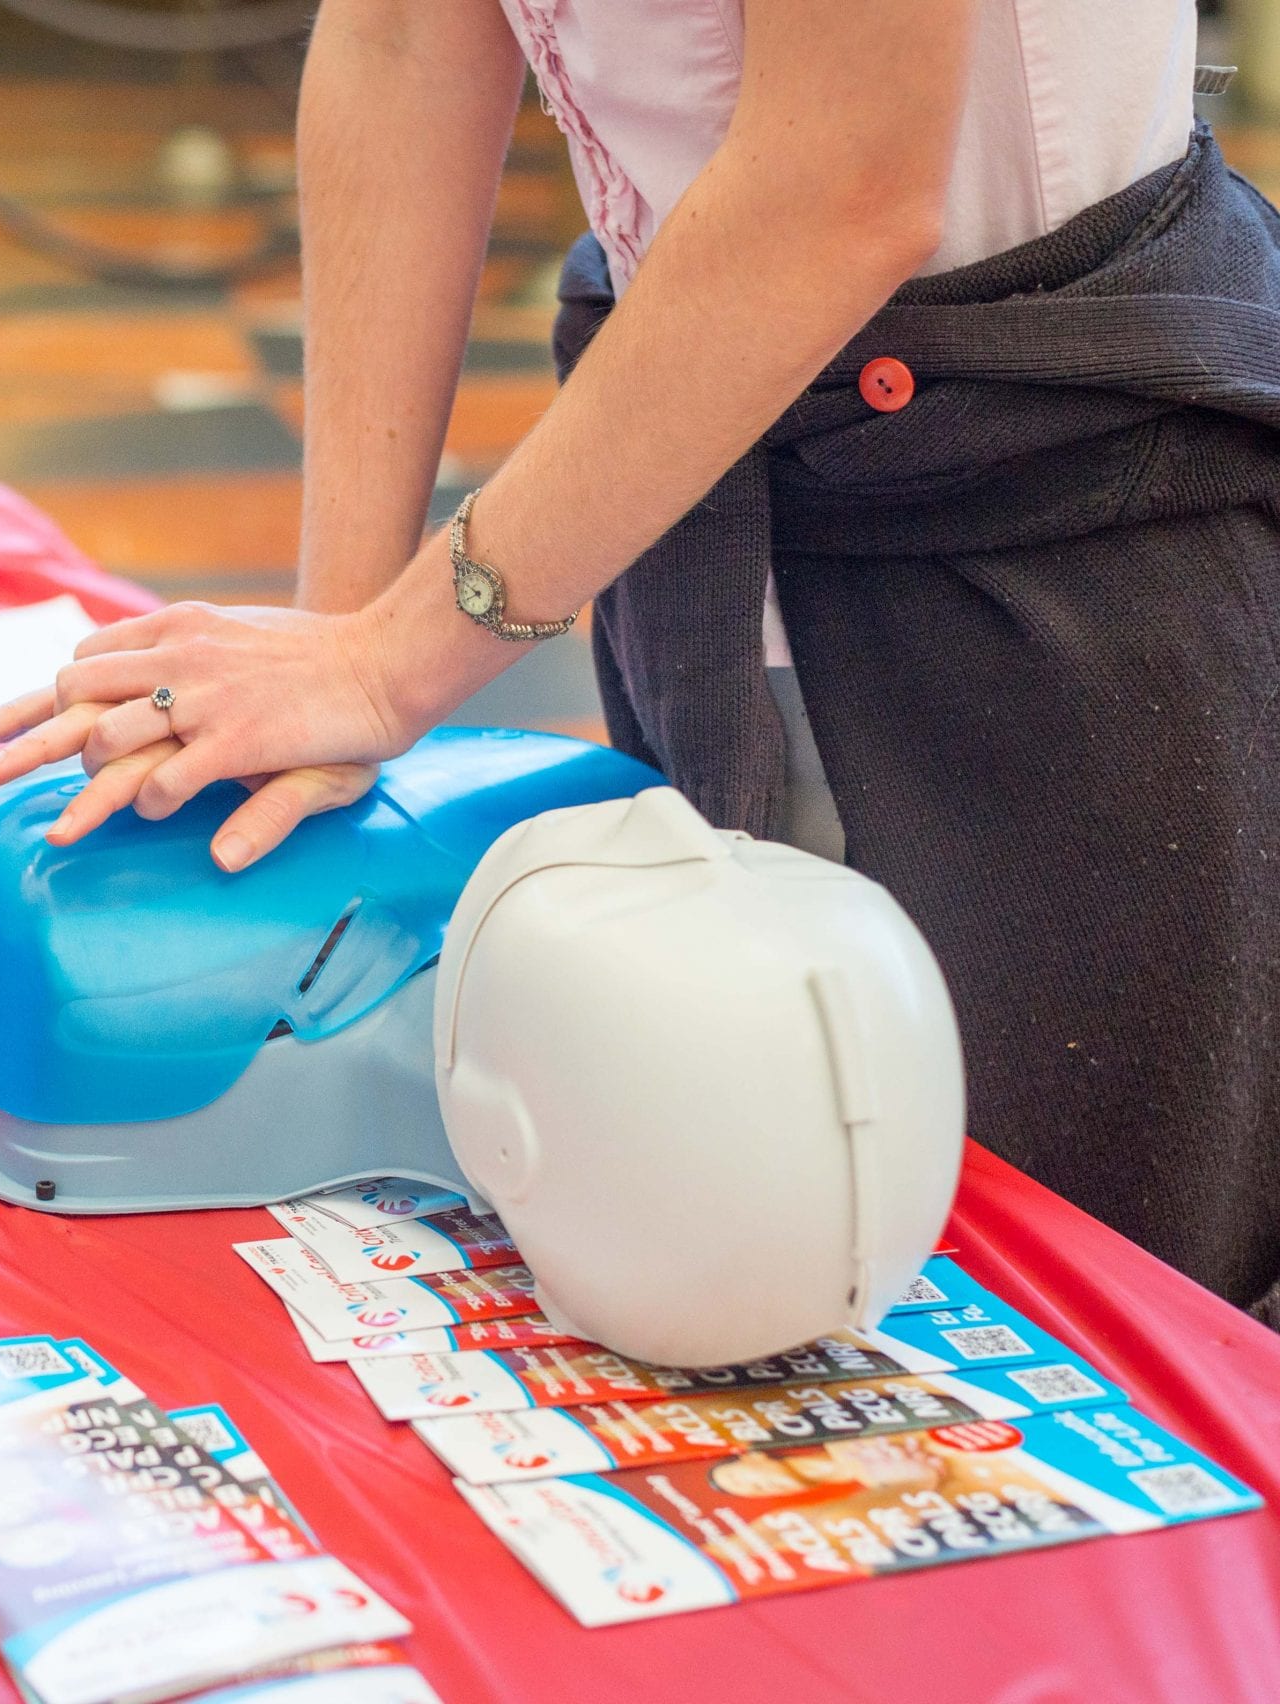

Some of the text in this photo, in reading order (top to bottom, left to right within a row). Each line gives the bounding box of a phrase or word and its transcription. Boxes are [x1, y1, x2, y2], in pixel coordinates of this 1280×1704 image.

[582, 1352, 649, 1390] ACLS
[814, 1340, 877, 1368] NRP
[749, 1399, 822, 1436] CPR
[785, 1387, 865, 1429] PALS
[838, 1388, 910, 1422] ECG
[881, 1384, 953, 1416] NRP
[648, 1402, 730, 1445] ACLS
[706, 1408, 775, 1441] BLS
[857, 1505, 953, 1556] CPR
[895, 1489, 1000, 1548] PALS
[950, 1490, 1043, 1539] ECG
[756, 1510, 861, 1570] ACLS
[815, 1517, 907, 1564] BLS
